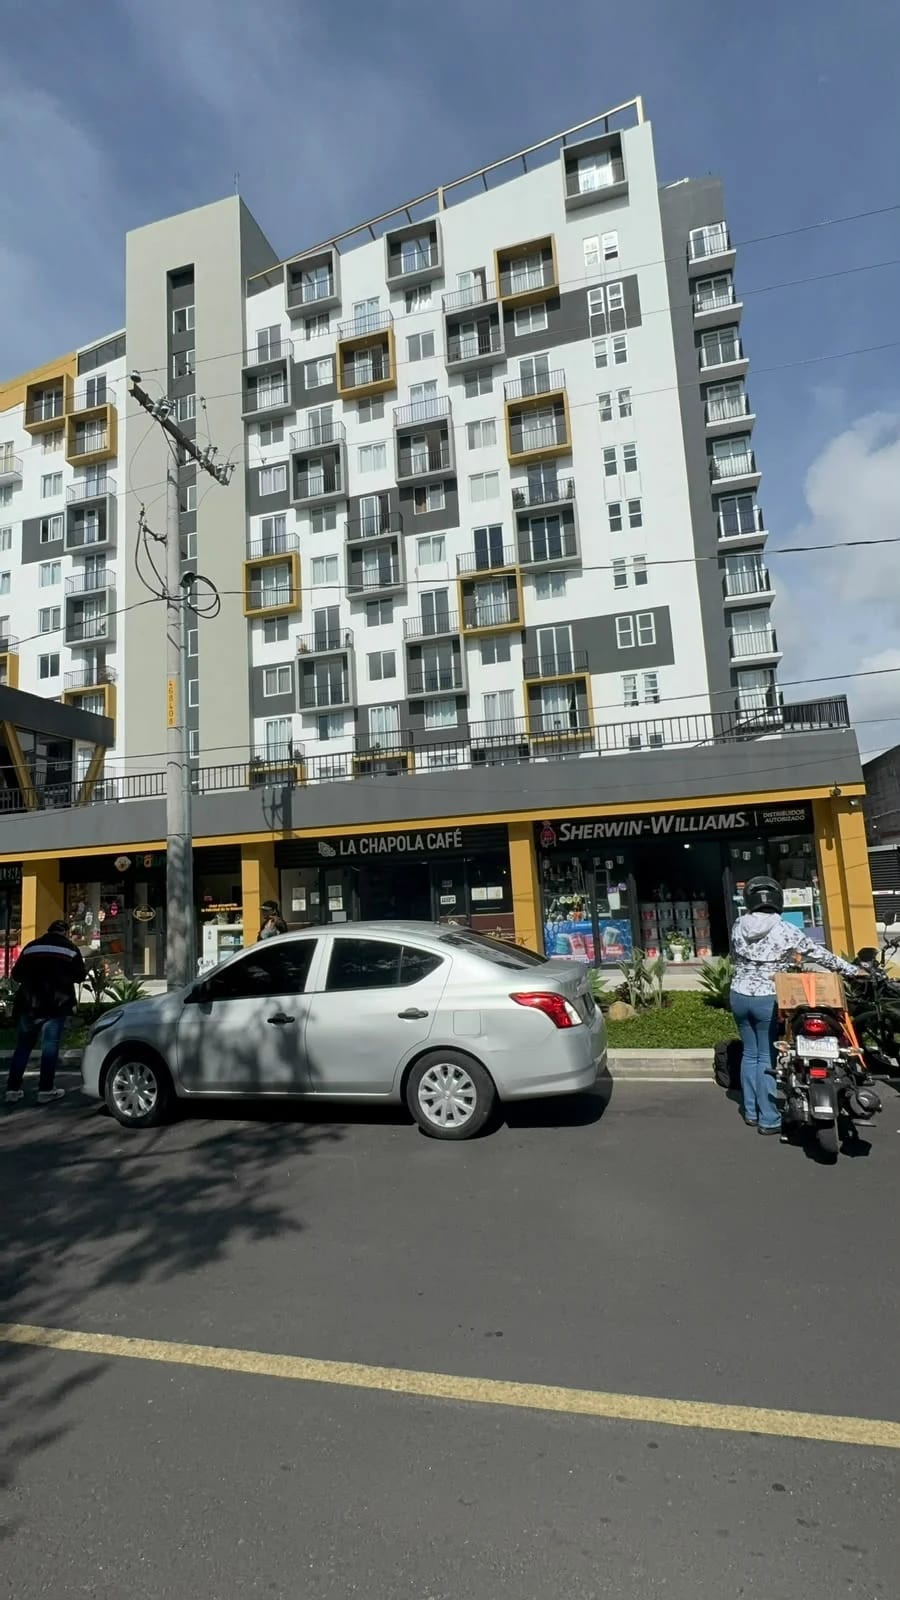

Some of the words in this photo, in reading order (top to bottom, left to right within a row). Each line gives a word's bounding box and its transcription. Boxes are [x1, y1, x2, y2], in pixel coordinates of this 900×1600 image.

[763, 809, 805, 818] DISTRIBUIDOR
[764, 815, 805, 824] AUTORIZADO
[559, 812, 746, 841] SHERWIN-WILLIAMS
[340, 839, 356, 855] LA
[360, 834, 424, 854] CHAPOLA
[427, 828, 462, 850] CAFÉ
